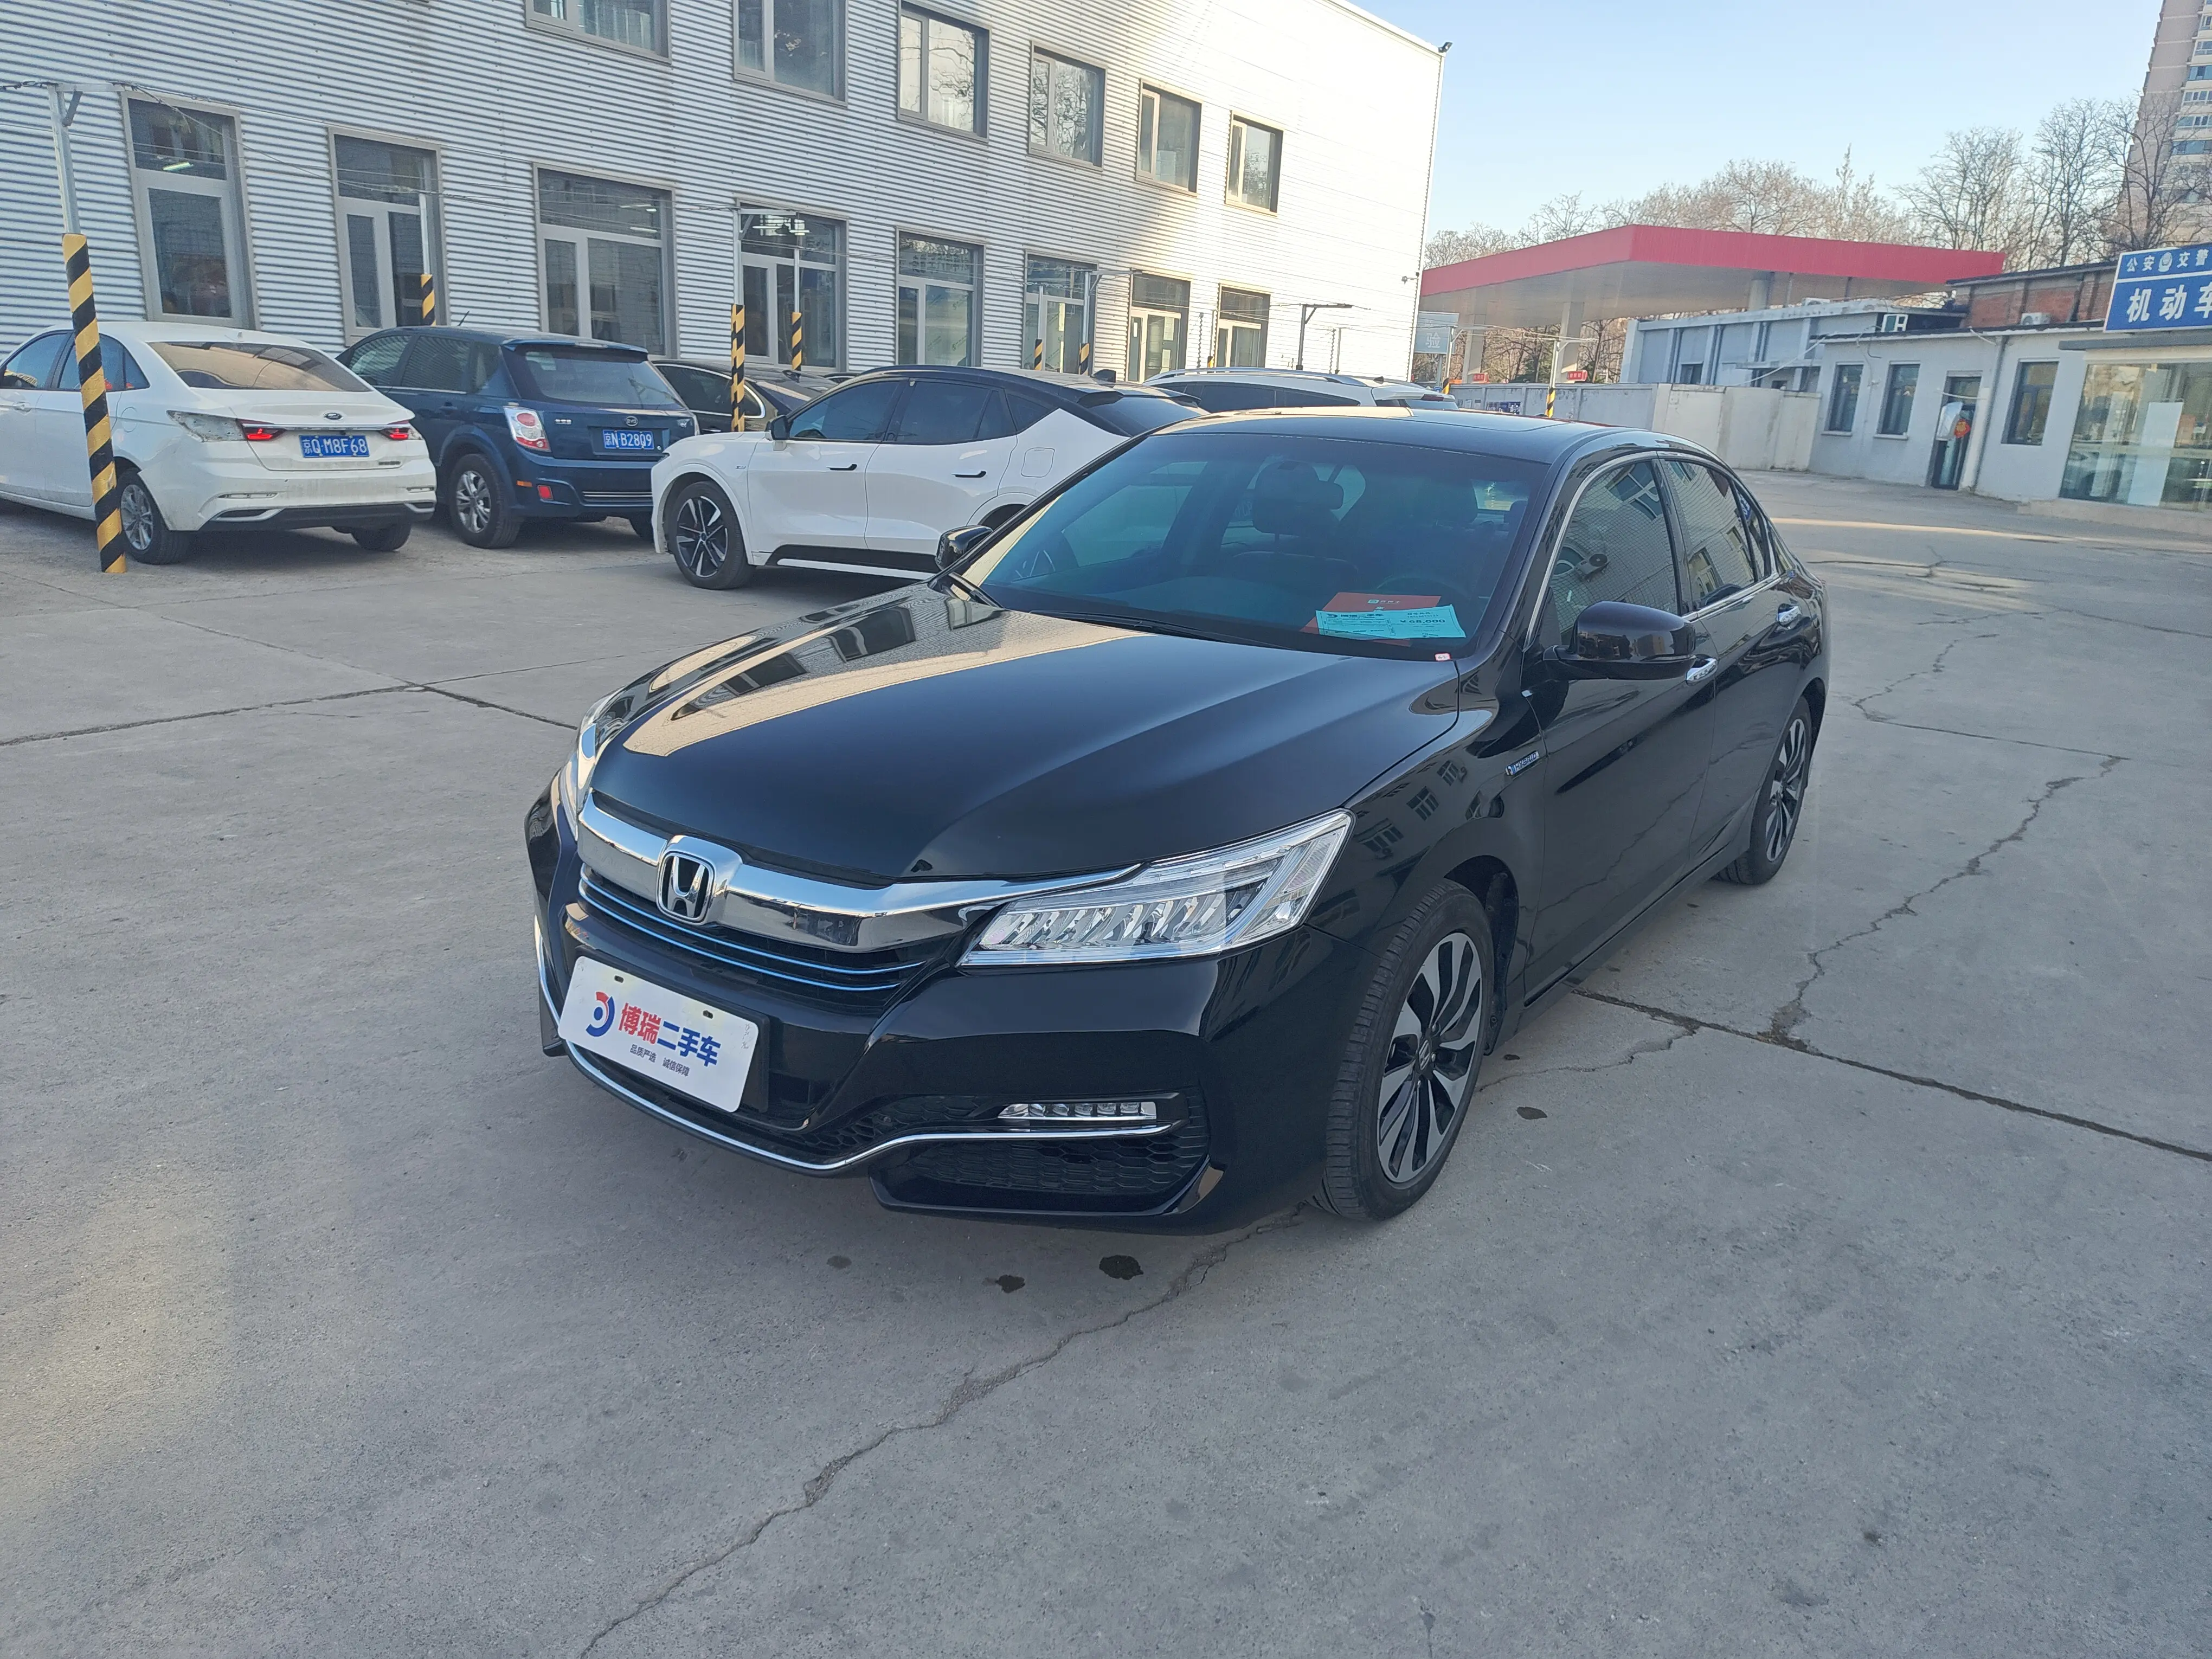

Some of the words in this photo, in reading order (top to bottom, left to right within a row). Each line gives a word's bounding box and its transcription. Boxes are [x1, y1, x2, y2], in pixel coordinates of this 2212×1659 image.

[2126, 281, 2212, 323] 机动车
[1515, 753, 1537, 771] HYBRID
[618, 1002, 722, 1068] 博瑞二手车
[629, 1044, 657, 1063] 品质严选
[662, 1057, 690, 1077] 诚信保障
